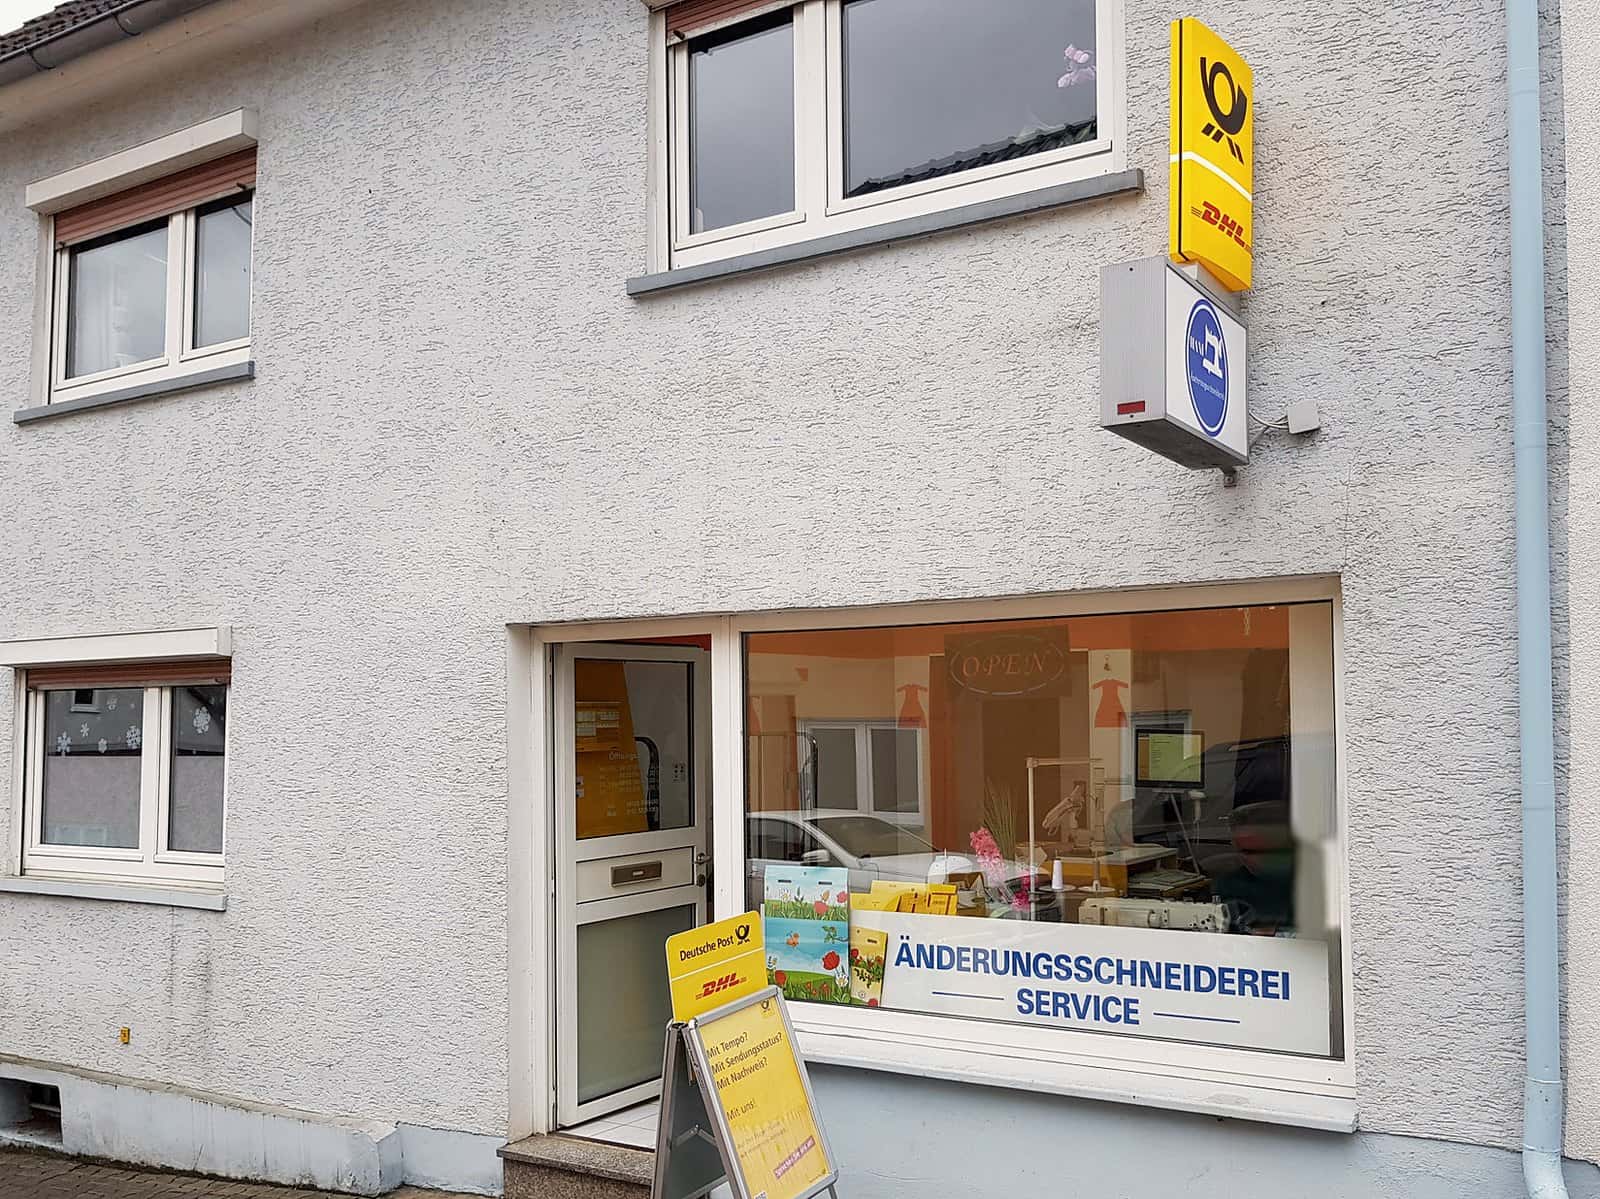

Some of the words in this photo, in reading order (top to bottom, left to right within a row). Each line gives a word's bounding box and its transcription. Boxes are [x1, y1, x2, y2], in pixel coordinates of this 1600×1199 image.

[1201, 200, 1246, 249] DHL
[961, 652, 1048, 679] OPEN
[679, 941, 716, 961] Deutsche
[717, 935, 734, 949] Post
[895, 935, 1292, 1001] ÄNDERUNGSSCHNEIDEREI
[702, 973, 740, 997] DHL
[1016, 988, 1140, 1026] SERVICE
[706, 1046, 721, 1059] Mit
[720, 1031, 748, 1053] Tempo?
[711, 1061, 726, 1075] Mit
[726, 1031, 783, 1068] Sendungsstatus?
[716, 1078, 731, 1090] Mit
[730, 1056, 768, 1083] Nachweis?
[726, 1108, 741, 1121] Mit
